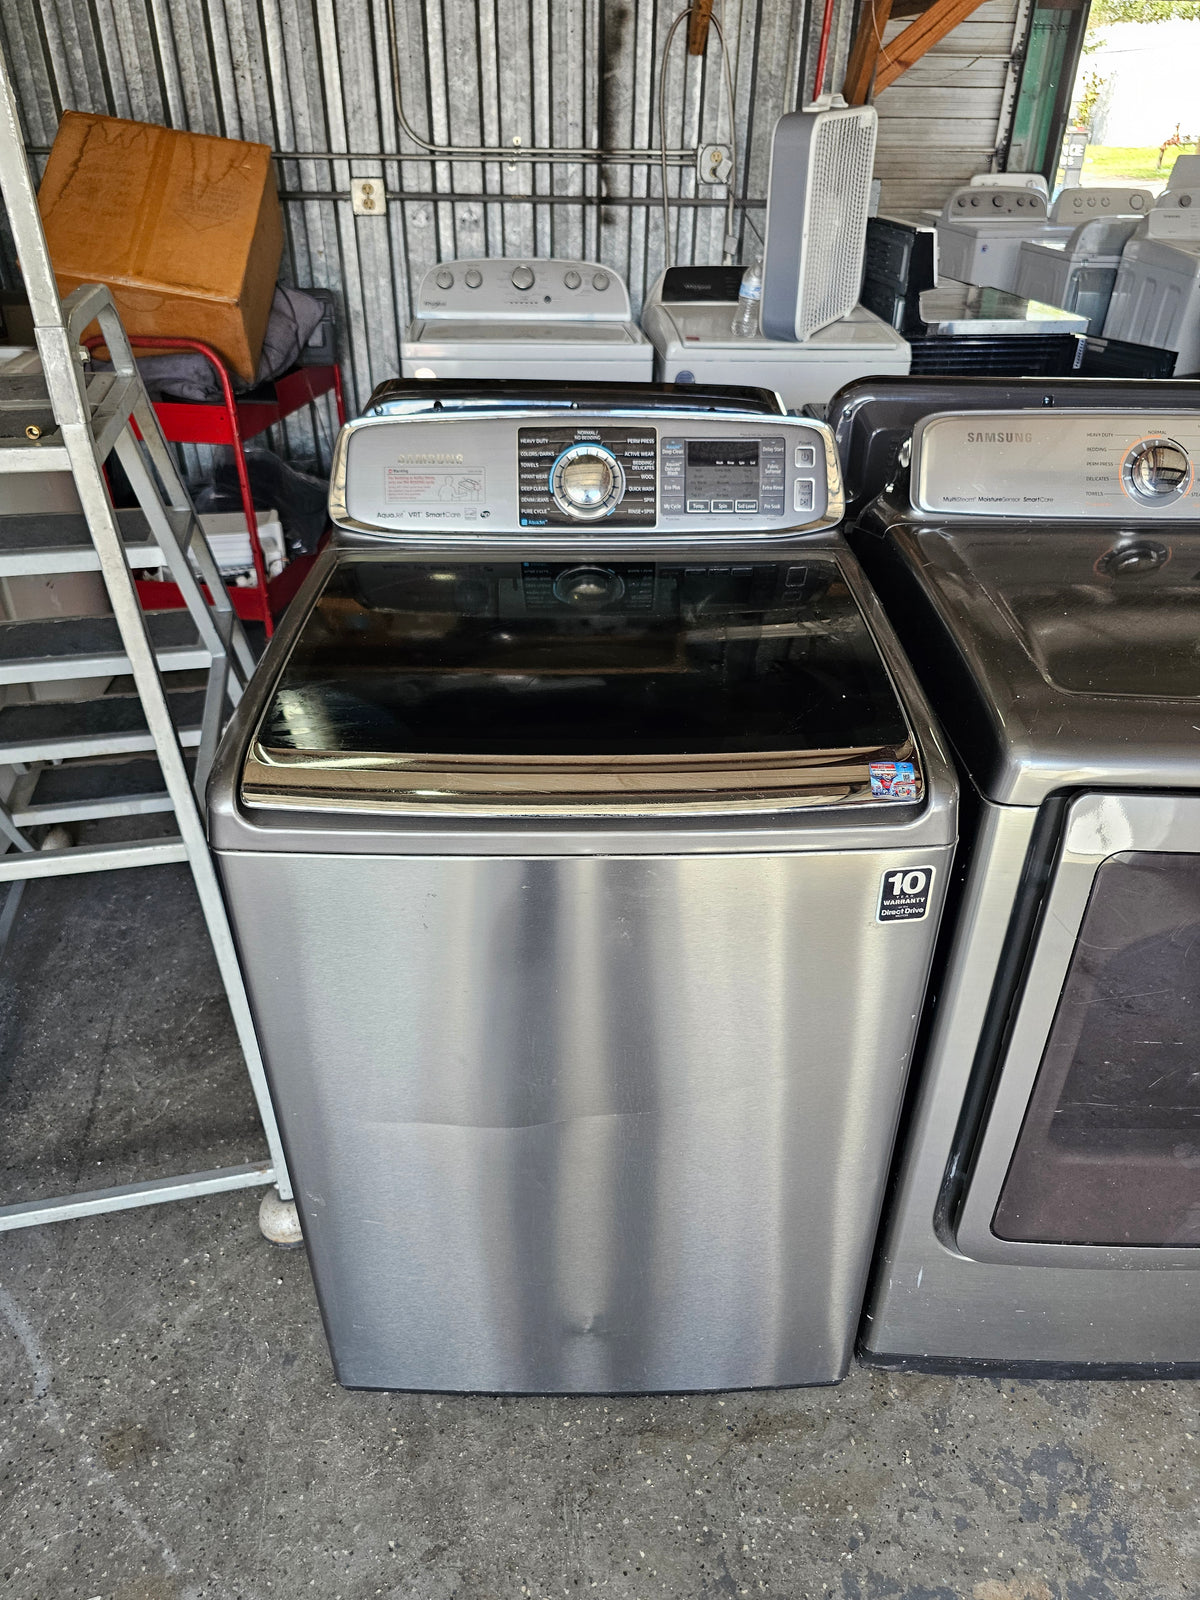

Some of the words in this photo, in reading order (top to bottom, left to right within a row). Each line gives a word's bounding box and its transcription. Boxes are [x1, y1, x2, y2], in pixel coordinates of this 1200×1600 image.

[967, 431, 1033, 443] SAMSUNG
[398, 454, 464, 465] SAMSUNG
[888, 871, 926, 896] 10
[883, 897, 926, 906] WARRANTY
[881, 908, 904, 916] Direct
